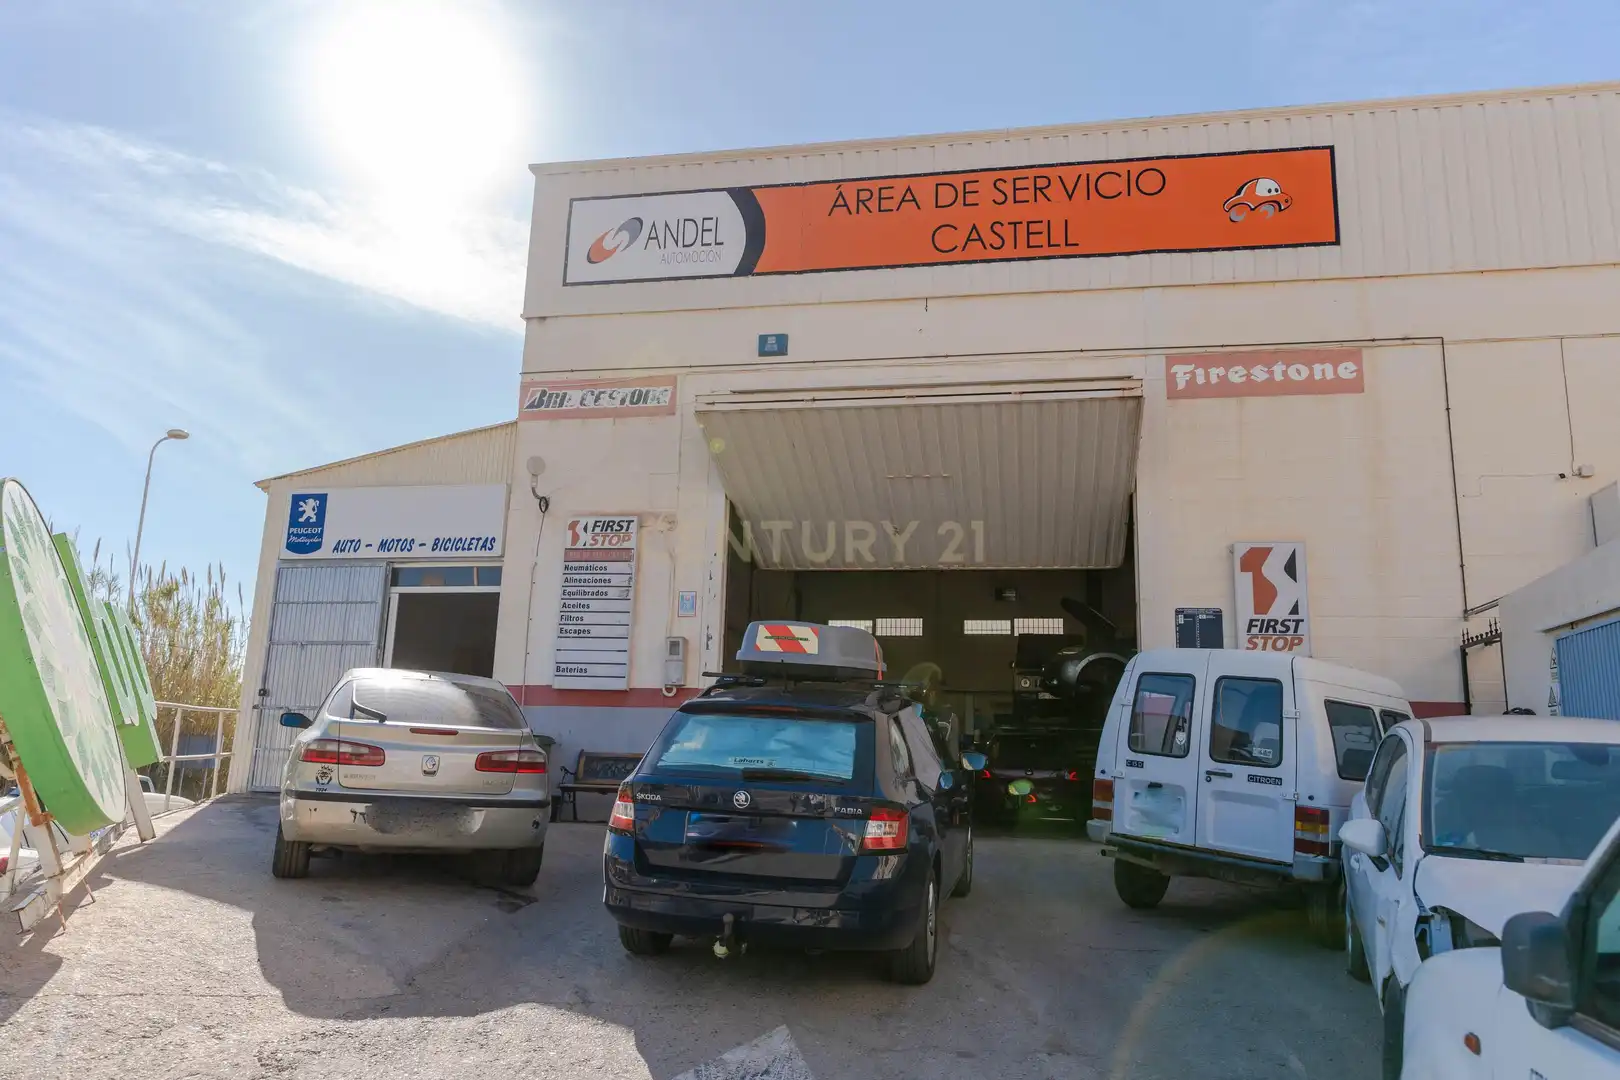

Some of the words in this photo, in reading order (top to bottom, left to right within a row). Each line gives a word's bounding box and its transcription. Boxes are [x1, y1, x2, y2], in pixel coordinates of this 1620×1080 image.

[828, 184, 921, 217] ÁREA
[933, 179, 980, 210] DE
[992, 167, 1167, 206] SERVICIO
[643, 216, 724, 250] ANDEL
[931, 218, 1080, 254] CASTELL
[660, 247, 722, 266] AUTOMOCIÓN
[1170, 359, 1359, 391] Firestone
[591, 519, 635, 533] FIRST
[332, 538, 362, 554] AUTO
[377, 537, 415, 553] MOTOS
[431, 535, 496, 552] BICICLETAS
[589, 533, 632, 547] STOP
[564, 563, 608, 571] Neumáticos
[563, 576, 612, 584] Alineaciones
[562, 589, 609, 597] Equilibrados
[560, 614, 584, 622] Filtros
[559, 627, 591, 635] Escapes
[1246, 618, 1305, 634] FIRST
[1245, 635, 1304, 652] STOP
[834, 806, 863, 815] FABIA
